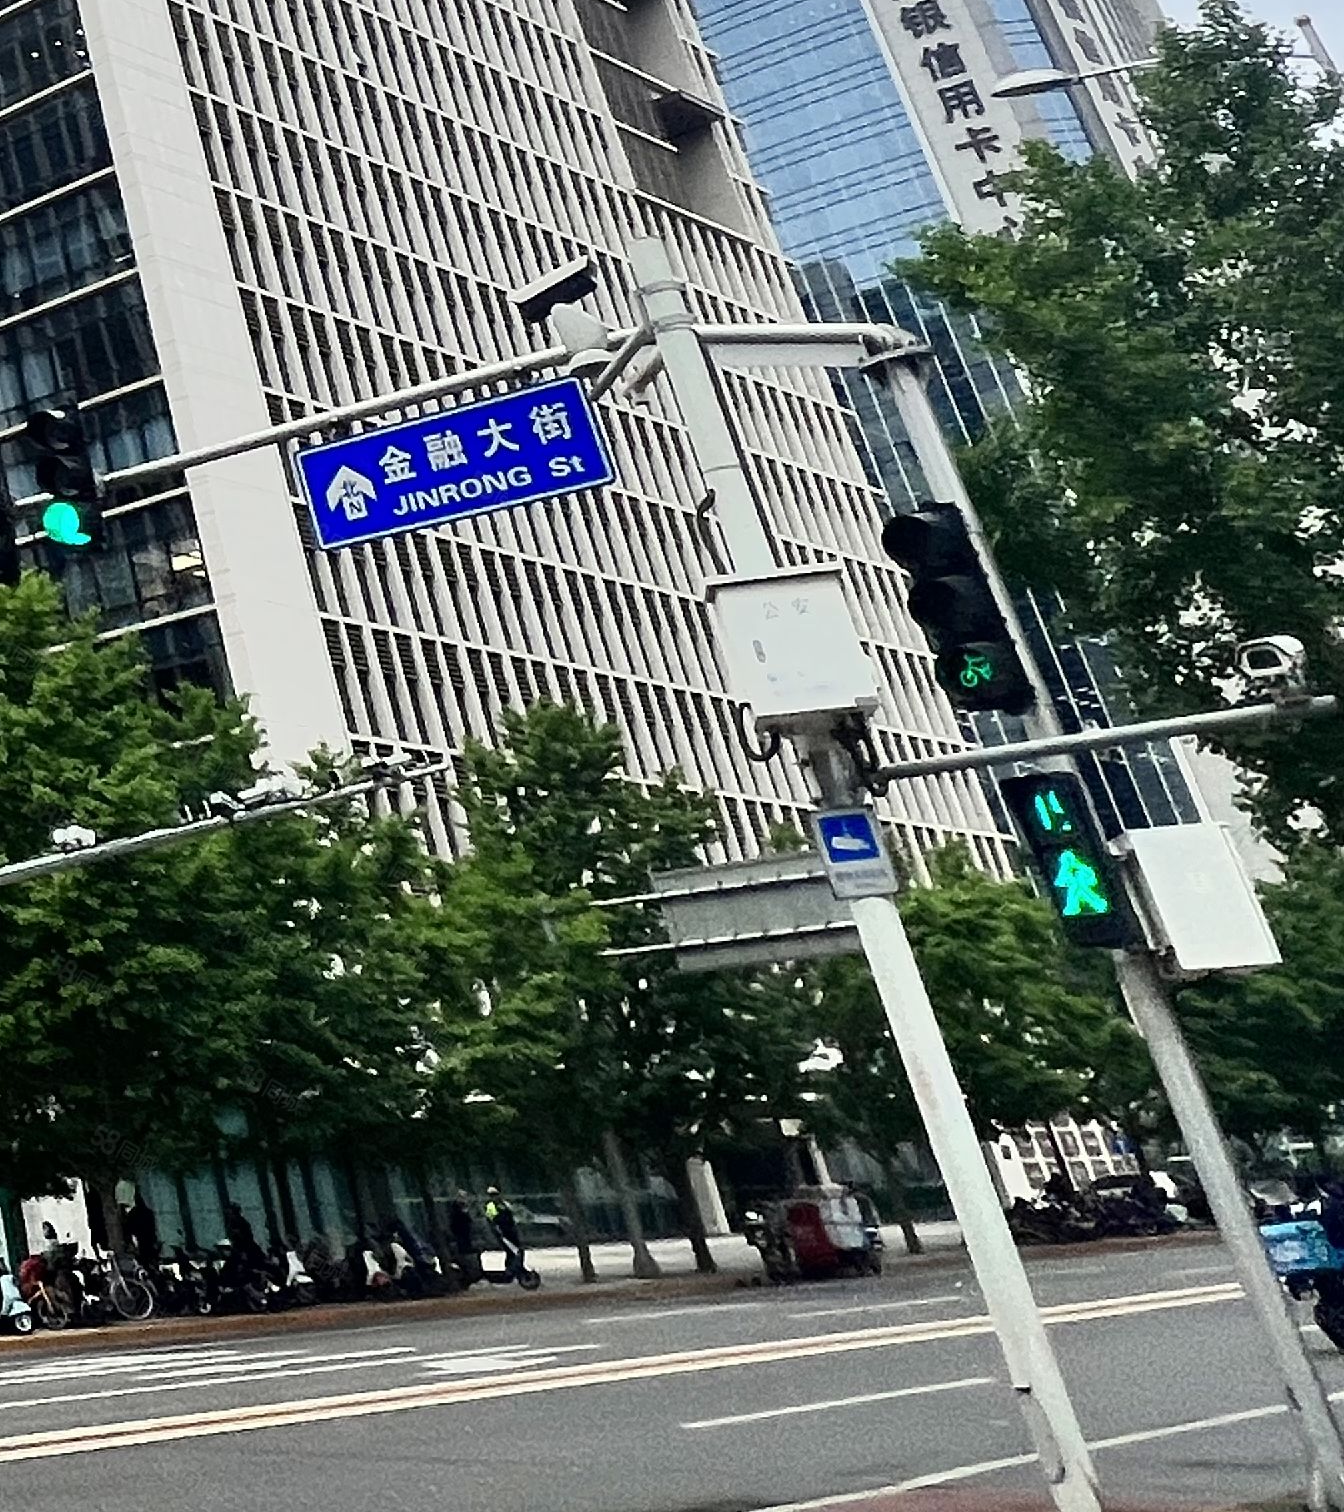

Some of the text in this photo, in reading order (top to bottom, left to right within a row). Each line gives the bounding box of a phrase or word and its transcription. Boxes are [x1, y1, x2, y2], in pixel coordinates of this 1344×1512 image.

[378, 402, 573, 485] 金融大街
[393, 455, 585, 516] JINRONG St
